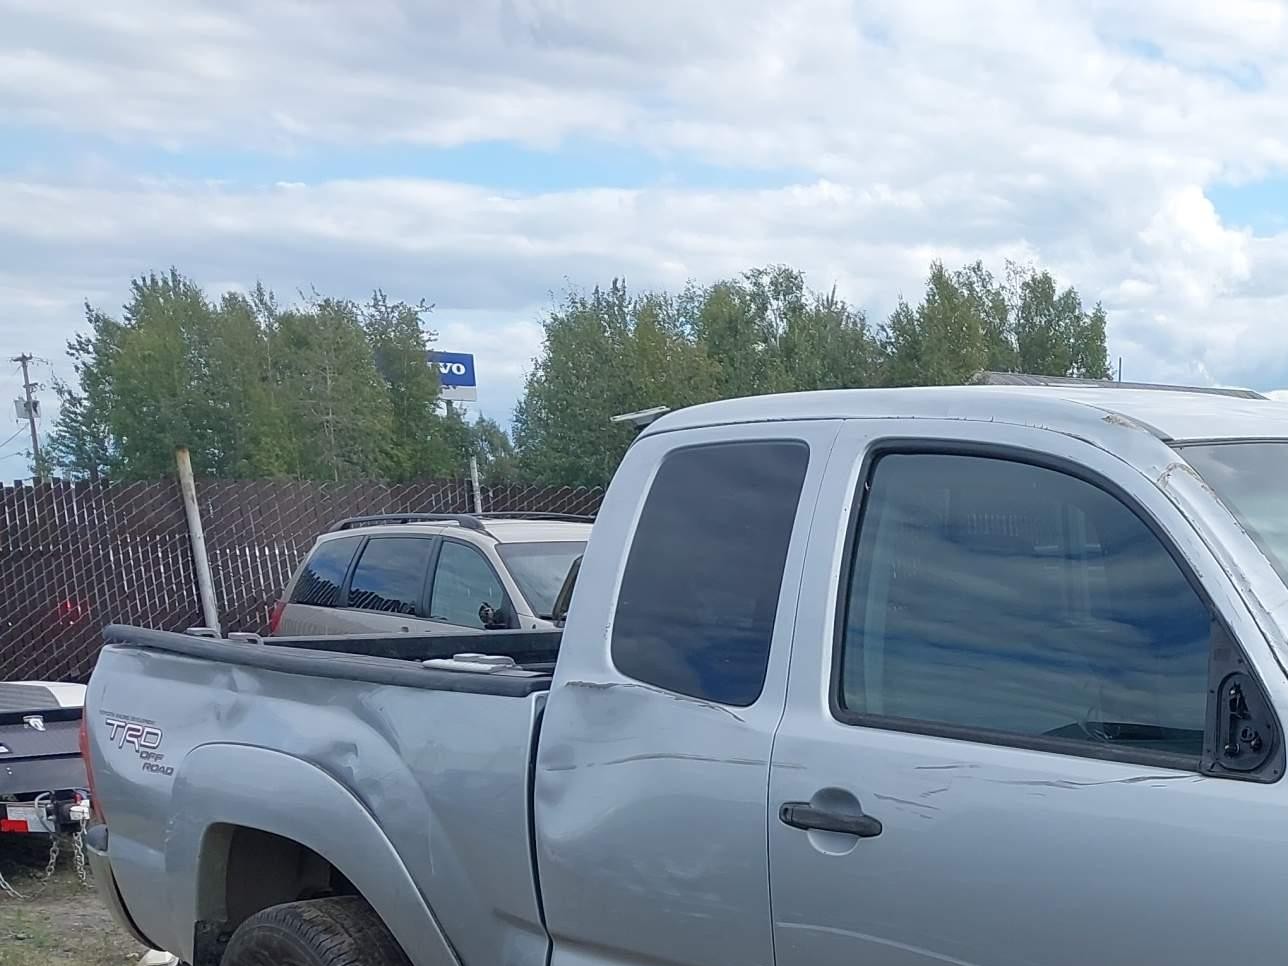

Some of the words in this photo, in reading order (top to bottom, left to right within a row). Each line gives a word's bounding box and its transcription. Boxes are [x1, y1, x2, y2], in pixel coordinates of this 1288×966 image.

[105, 718, 163, 753] TRD
[139, 750, 164, 762] OFF
[142, 762, 174, 776] ROAD
